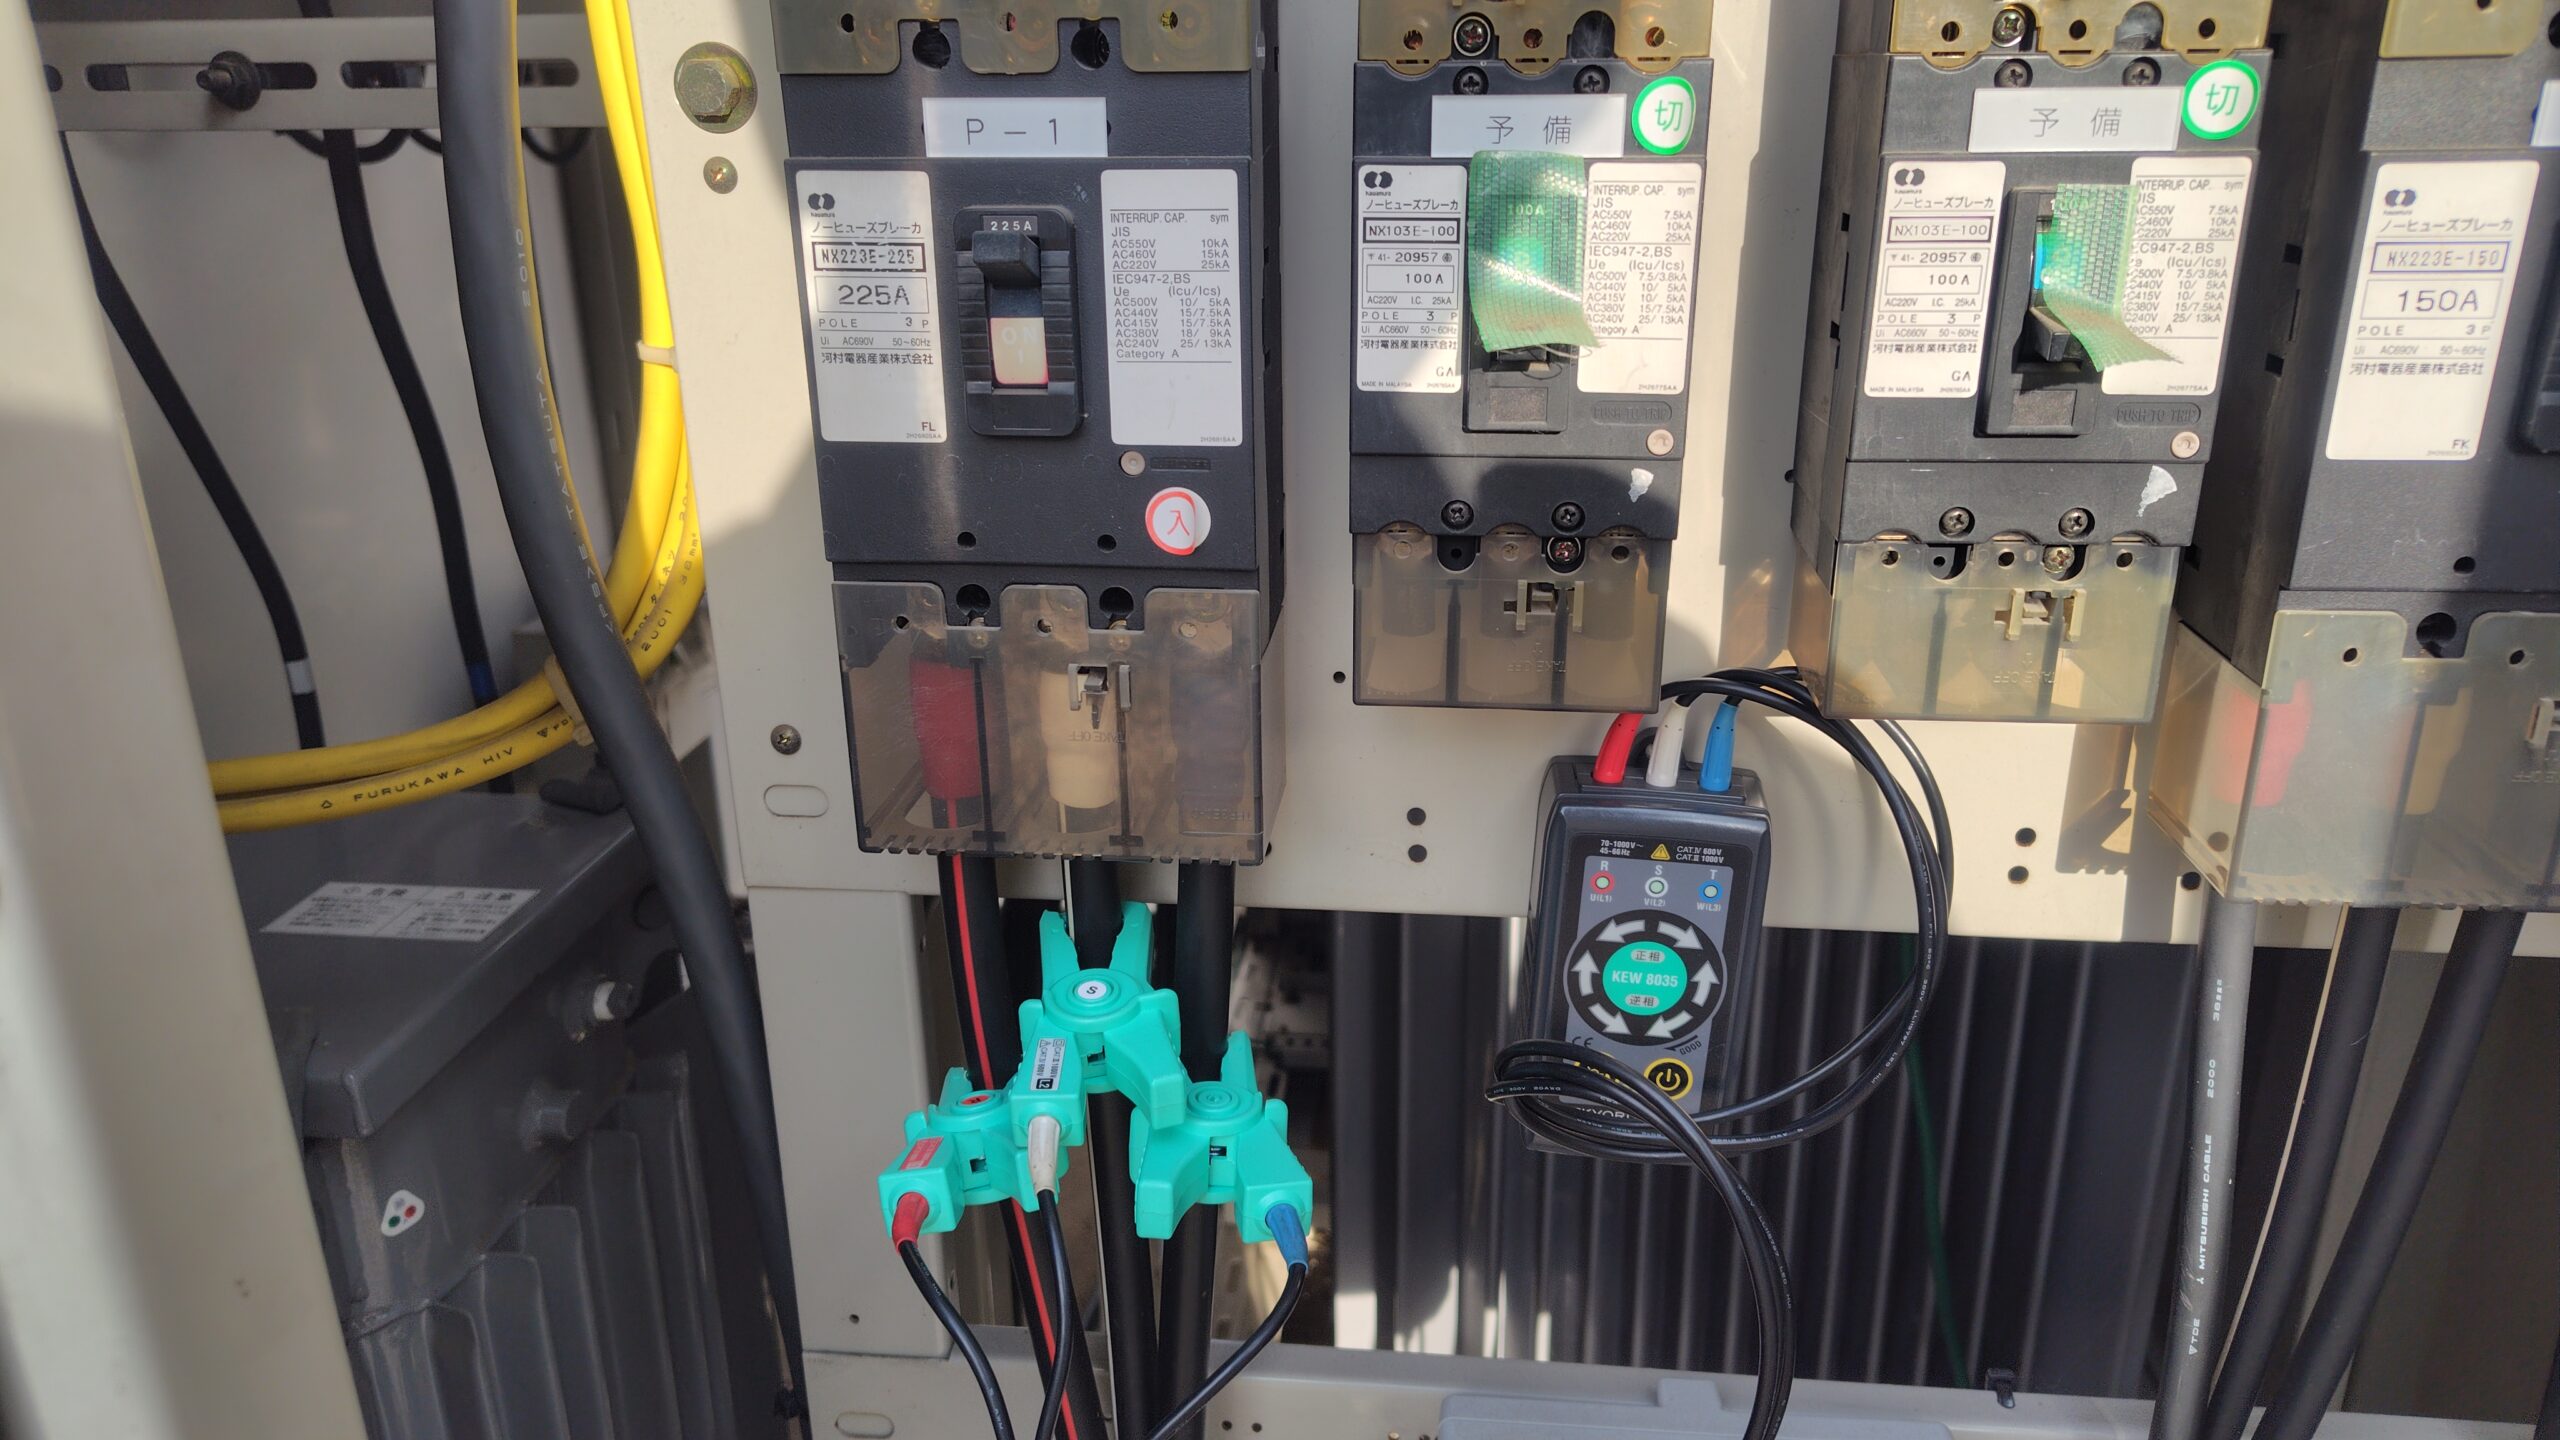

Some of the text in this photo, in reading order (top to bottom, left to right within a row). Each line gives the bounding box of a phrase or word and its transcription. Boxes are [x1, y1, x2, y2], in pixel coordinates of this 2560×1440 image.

[2204, 82, 2240, 117] 切
[1655, 100, 1684, 131] 切
[2029, 107, 2122, 138] 予備
[1486, 115, 1572, 145] 予備
[1677, 186, 1695, 197] sym
[2224, 181, 2244, 192] sym
[1365, 199, 1459, 211] ノーヒューズブレーカ
[1593, 197, 1613, 208] JIS
[1894, 197, 1994, 209] ノーヒューズブレーカ
[1210, 213, 1229, 224] sym
[1592, 210, 1693, 220] AC550V 7.5kA
[990, 220, 1032, 231] 225A
[1591, 221, 1691, 231] AC460V 10kA
[2211, 217, 2237, 226] 10kA
[2380, 217, 2513, 232] ノーヒューズブレーカ
[812, 221, 921, 234] ノーヒューズブレーカ
[1111, 226, 1130, 237] JIS
[1369, 225, 1455, 237] NX103E-100
[1894, 225, 1988, 237] NX103E-100
[2208, 228, 2235, 238] 25kA
[1590, 232, 1691, 241] AC220V 25kA
[1111, 238, 1229, 248] AC550V 10kA
[821, 248, 915, 264] NX223E-225
[1112, 249, 1229, 259] AC460V 15kA
[1395, 252, 1438, 263] 20957
[1919, 252, 1967, 263] 20957
[2387, 251, 2500, 267] NX223E-150
[515, 227, 531, 307] 2010
[1112, 260, 1230, 269] AC220V 25kA
[1588, 259, 1606, 269] Ue
[1405, 273, 1444, 284] 100A
[1588, 272, 1627, 281] AC500V
[1929, 274, 1970, 285] 100A
[1113, 286, 1130, 296] Ue
[1587, 282, 1626, 291] AC440V
[837, 284, 910, 306] 225A
[1367, 296, 1398, 304] AC220V
[1432, 296, 1452, 305] 25kA
[1587, 293, 1626, 302] AC415V
[2397, 289, 2479, 312] 150A
[1114, 297, 1158, 307] AC500V
[1884, 297, 1976, 307] AC220V 25kA
[1114, 308, 1158, 317] AC440V
[1586, 304, 1625, 312] AC380V
[1362, 312, 1399, 320] POLE
[1426, 311, 1435, 321] 3
[1876, 314, 1918, 323] POLE
[1947, 313, 1956, 324] 3
[818, 316, 929, 329] POLE 3 P
[1115, 318, 1158, 328] AC415V
[1116, 329, 1159, 338] AC380V
[1361, 325, 1370, 334] Ui
[2357, 325, 2405, 336] POLE
[2466, 324, 2475, 335] 3
[842, 337, 874, 346] AC690V
[1116, 339, 1159, 348] AC240V
[1361, 339, 1457, 350] 河村電器産業株式会社
[821, 352, 934, 365] 河村電器産業株式会社
[1116, 349, 1179, 360] Category A
[1435, 366, 1454, 377] GA
[2349, 362, 2484, 375] 河村電器産業株式会社
[1951, 370, 1971, 382] GA
[921, 421, 936, 431] FL
[535, 366, 574, 520] TATSUTA
[2452, 439, 2470, 449] FK
[1166, 509, 1190, 536] 入
[353, 747, 514, 802] FURUKAWA HIV
[1600, 861, 1609, 871] R
[1655, 865, 1663, 875] S
[1710, 869, 1718, 879] T
[1612, 970, 1679, 987] KEW 8035
[2206, 1059, 2217, 1099] 2000
[2203, 1134, 2212, 1184] CABLE
[2198, 1188, 2210, 1271] MITSUBISHI
